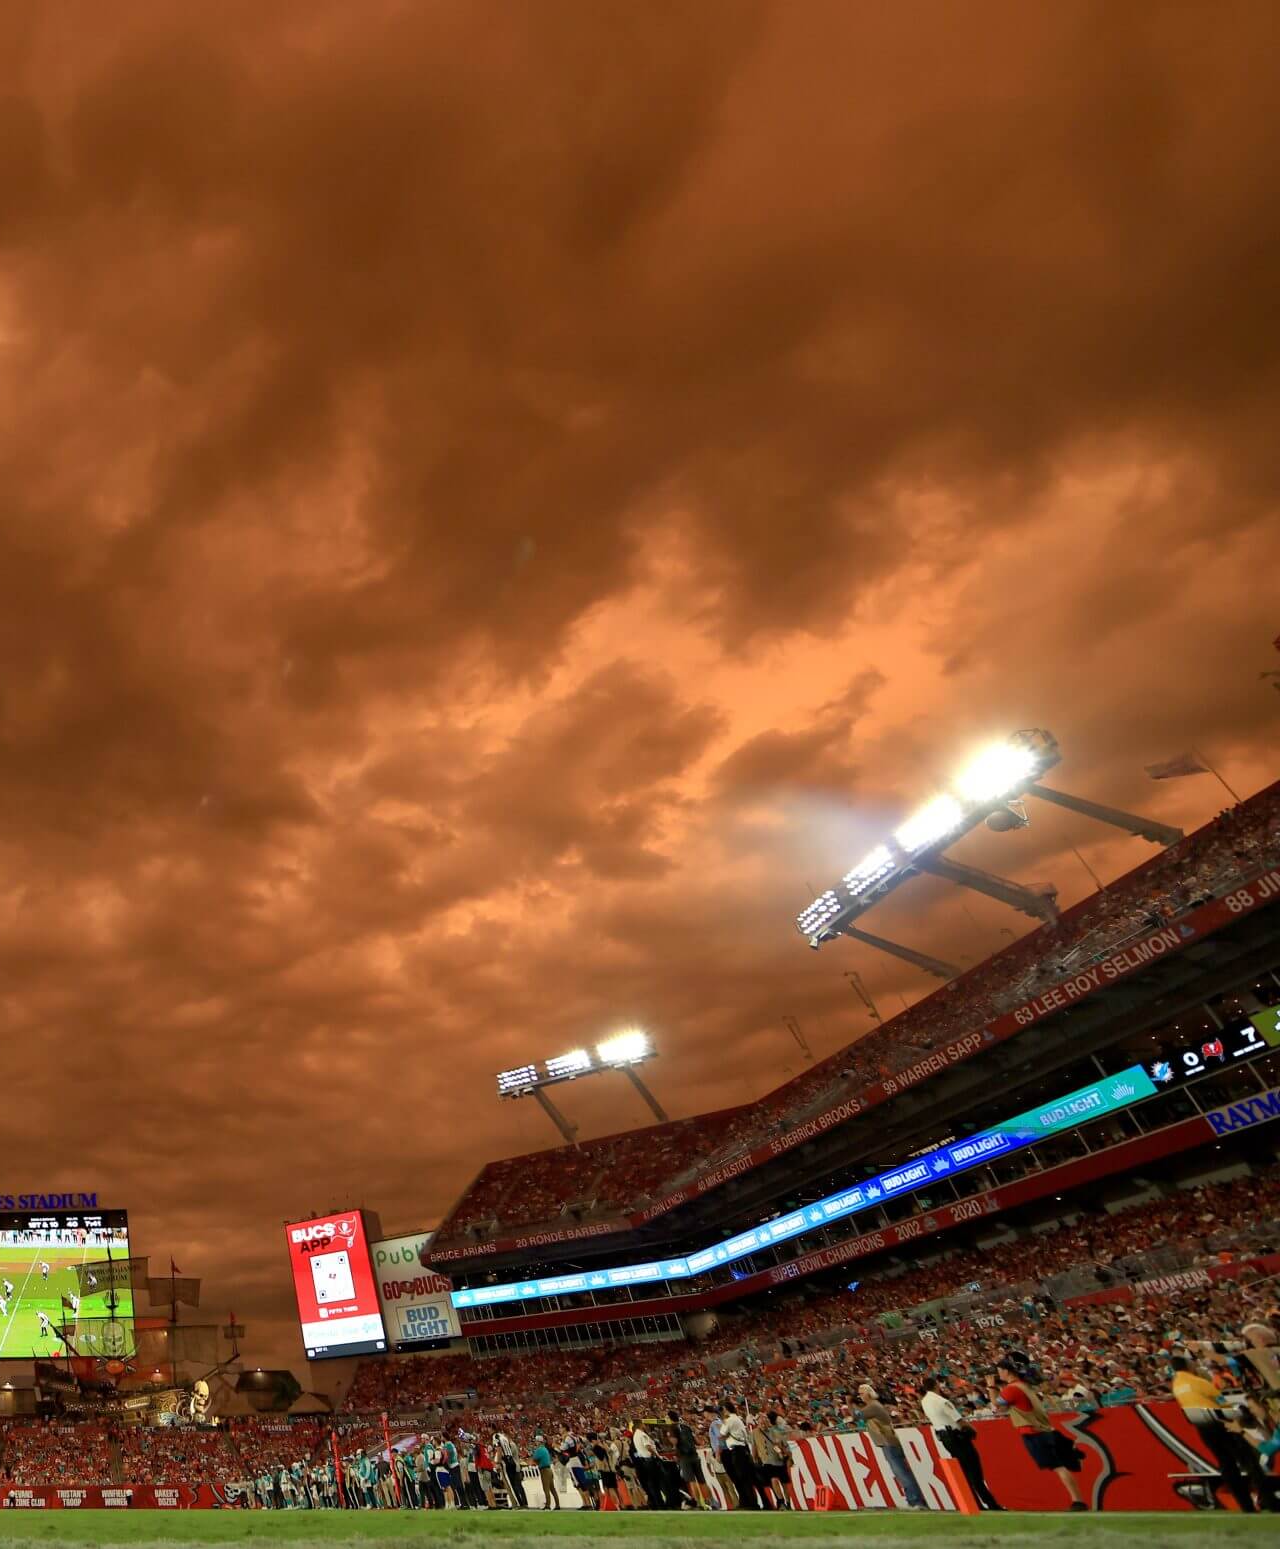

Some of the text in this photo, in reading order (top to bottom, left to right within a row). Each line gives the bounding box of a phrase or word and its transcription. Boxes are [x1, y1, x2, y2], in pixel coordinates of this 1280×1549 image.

[1225, 889, 1254, 912] 88
[1013, 928, 1181, 1025] 63 LEE ROY SELMON
[1240, 1026, 1256, 1043] 7
[883, 1033, 981, 1095] 99 WARREN SAPP
[1183, 1052, 1199, 1066] 0
[1040, 1093, 1100, 1126] BUD LIGHT
[770, 1099, 861, 1153] 55 DERRICK BROOKS
[952, 1145, 977, 1162] BUD
[974, 1133, 1004, 1154] LIGHT
[705, 1172, 723, 1187] MIKE
[722, 1155, 753, 1179] ALSTOTT
[883, 1164, 927, 1190] BUD LIGHT
[18, 1193, 97, 1209] STADIUM
[823, 1191, 862, 1213] BUD LIGHT
[950, 1201, 982, 1222] 2020
[291, 1223, 336, 1243] BUCS
[516, 1223, 611, 1249] 20 RONDE BARBER
[895, 1221, 922, 1241] 2002
[301, 1237, 331, 1253] APP
[375, 1242, 424, 1268] Publ
[430, 1244, 496, 1262] BRUCE ARIANS
[770, 1233, 885, 1281] SUPER BOWL CHAMPIONS
[382, 1273, 451, 1300] GO BUCS
[405, 1307, 439, 1323] BUD
[975, 1314, 1005, 1330] 1976
[402, 1320, 448, 1338] LIGHT
[816, 1488, 826, 1506] 10
